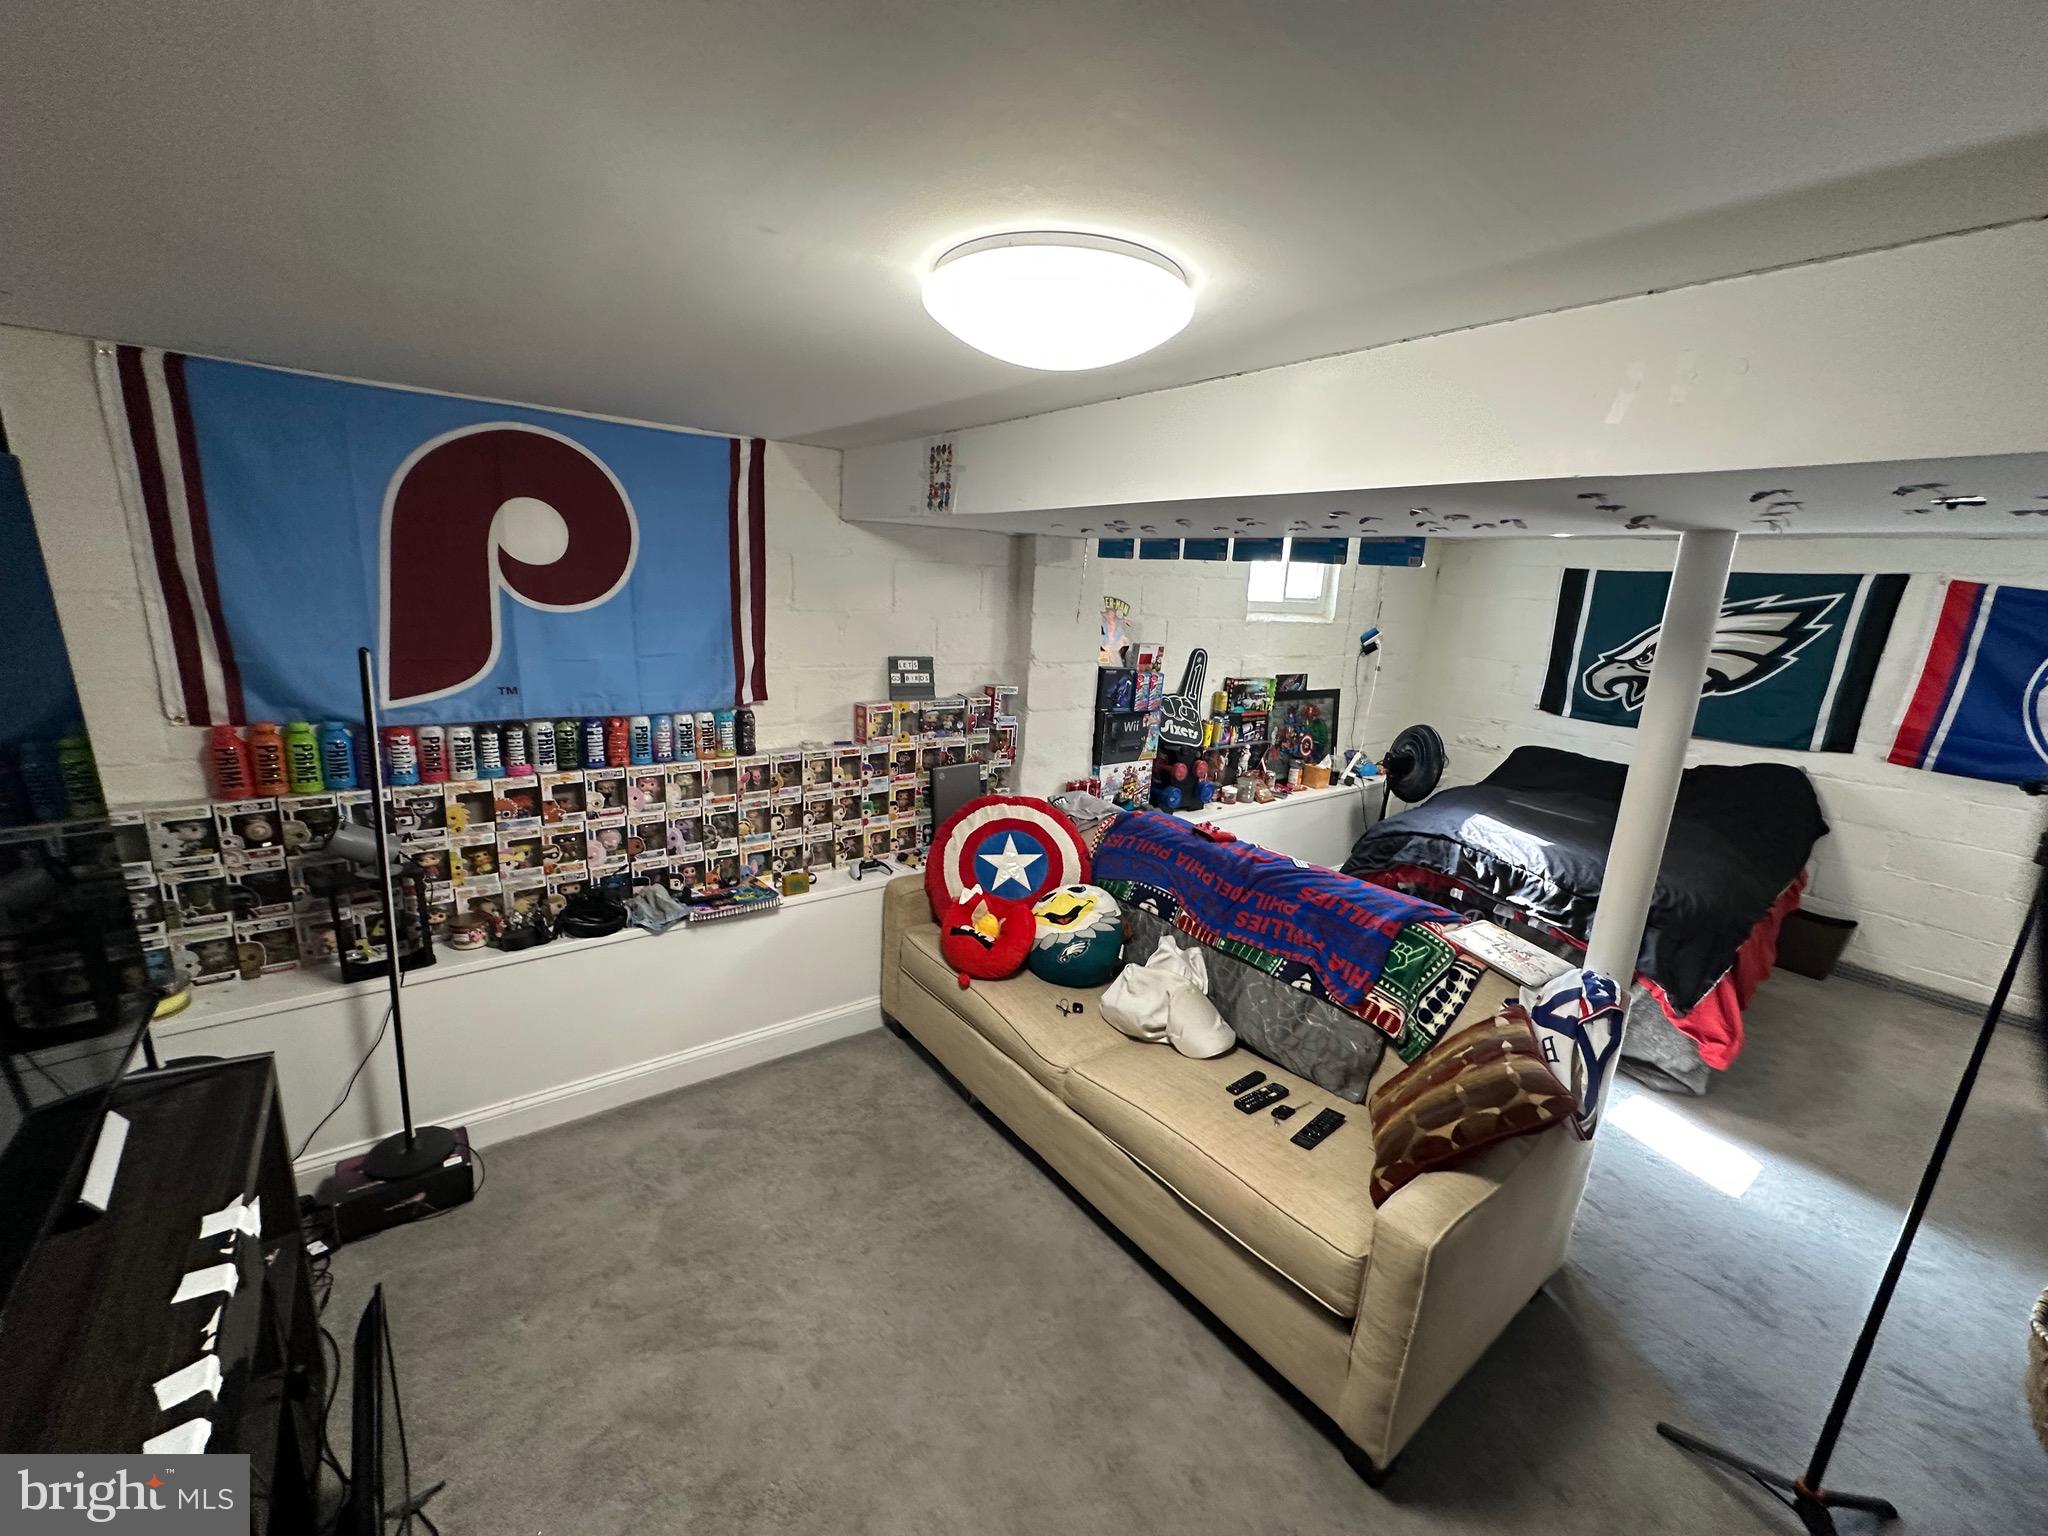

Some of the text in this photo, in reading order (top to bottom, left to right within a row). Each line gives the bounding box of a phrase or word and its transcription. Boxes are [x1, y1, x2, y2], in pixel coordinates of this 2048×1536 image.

[379, 421, 640, 709] P
[891, 674, 929, 682] GO BIRDS
[898, 661, 918, 669] LETS
[496, 686, 519, 696] TM
[587, 726, 605, 762] PRIME
[635, 725, 650, 759] PRIME
[657, 723, 672, 757] PRIME
[680, 722, 694, 756] PRIME
[702, 720, 716, 752] PRIME
[720, 720, 734, 751] PRIME
[1123, 721, 1140, 733] Wii
[1160, 719, 1199, 740] Sixers
[256, 744, 283, 785] PRIME
[293, 743, 319, 783] PRIME
[327, 741, 350, 780] PRIME
[390, 735, 414, 775] PRIME
[422, 736, 443, 773] PRIME
[454, 736, 474, 772] PRIME
[481, 732, 501, 769] PRIME
[506, 730, 526, 767] PRIME
[537, 729, 556, 766] PRIME
[1297, 886, 1403, 939] PHILLIES
